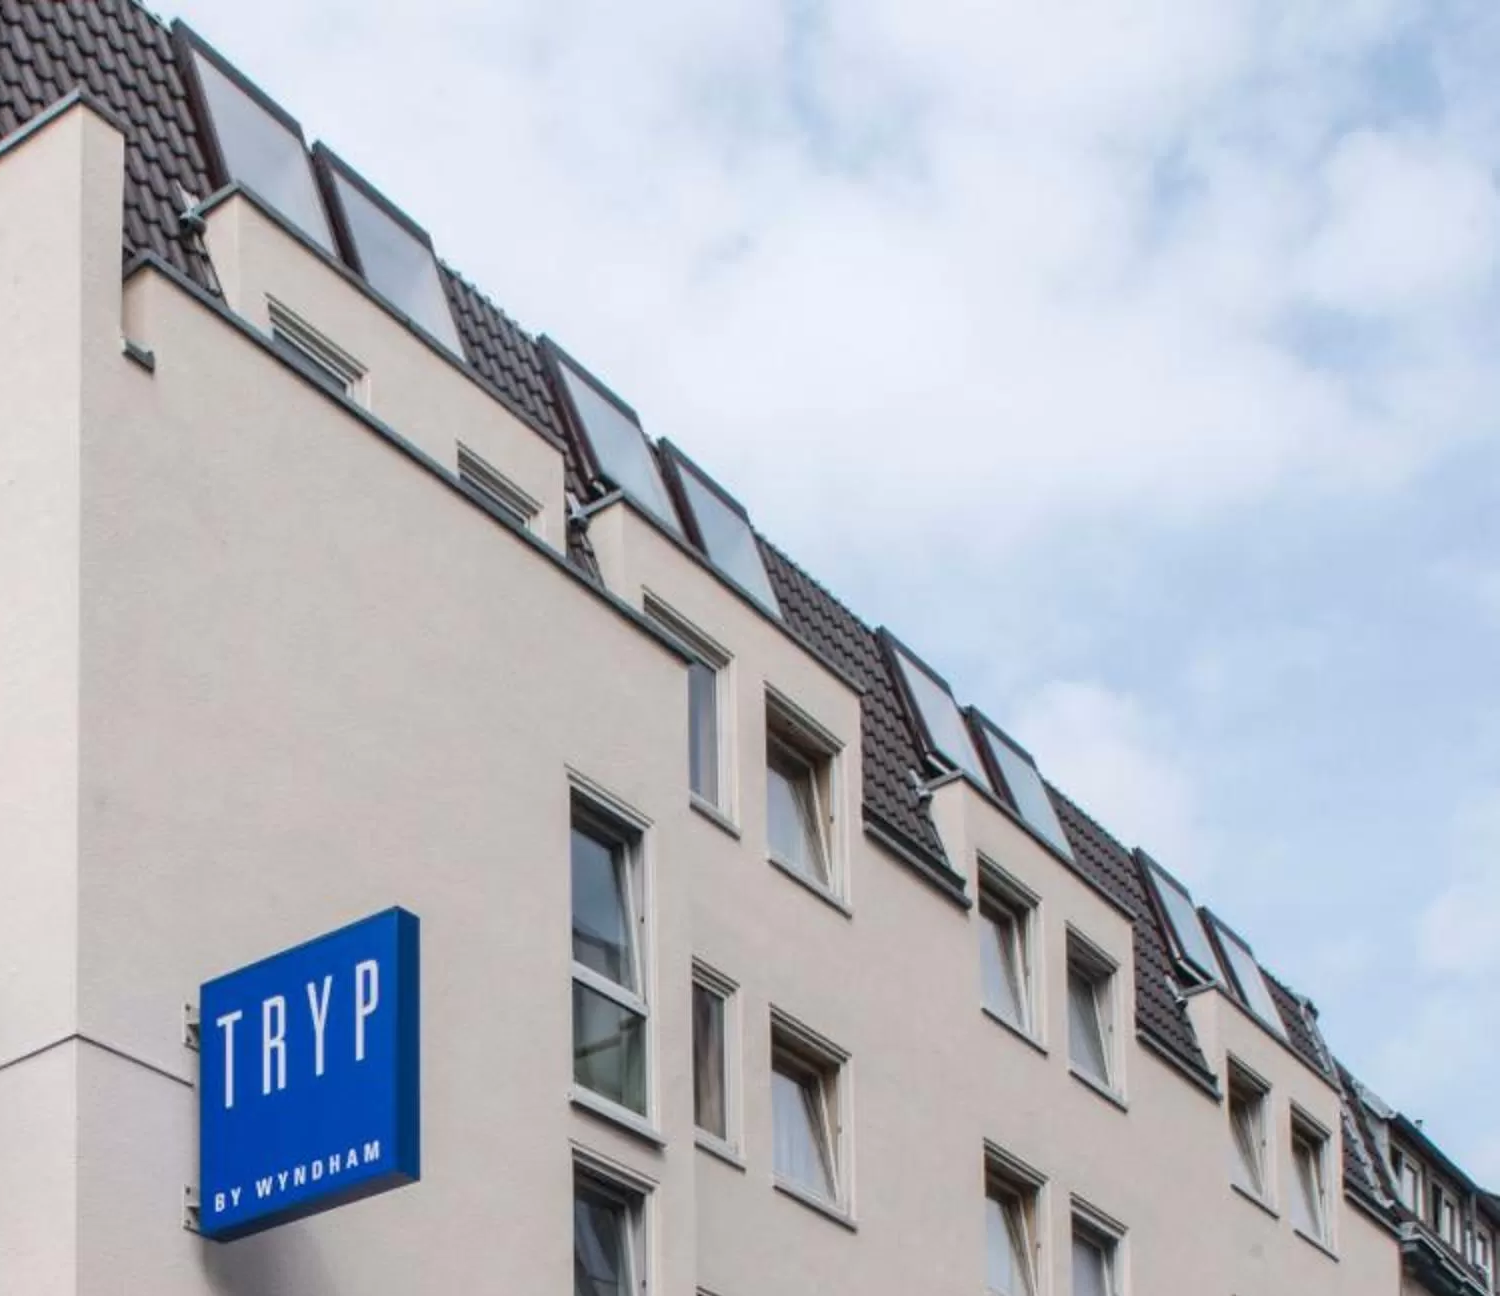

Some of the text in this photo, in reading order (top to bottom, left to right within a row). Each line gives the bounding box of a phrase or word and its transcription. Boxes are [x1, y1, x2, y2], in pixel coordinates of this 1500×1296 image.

[216, 958, 380, 1110] TRYP
[214, 1139, 381, 1213] BY WYNDHAM
